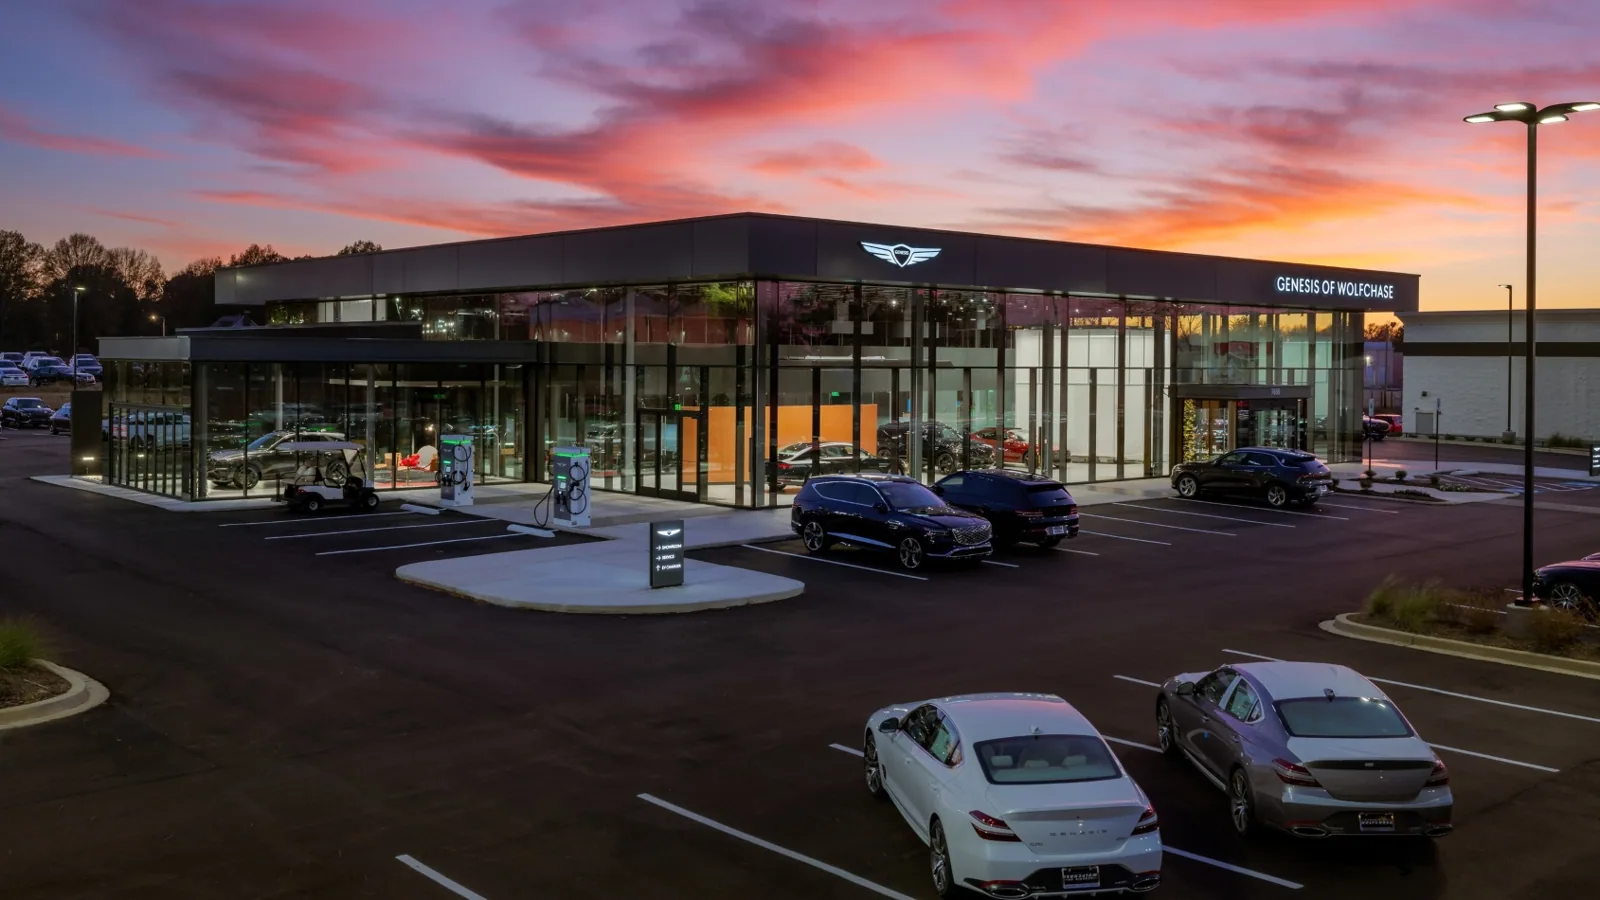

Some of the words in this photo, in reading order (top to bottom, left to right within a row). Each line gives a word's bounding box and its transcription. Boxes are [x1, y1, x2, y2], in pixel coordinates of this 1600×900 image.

[1277, 276, 1320, 293] GENESIS
[1321, 279, 1336, 295] OF
[1336, 281, 1394, 299] WOLFCHASE
[1049, 829, 1108, 837] GENESIS
